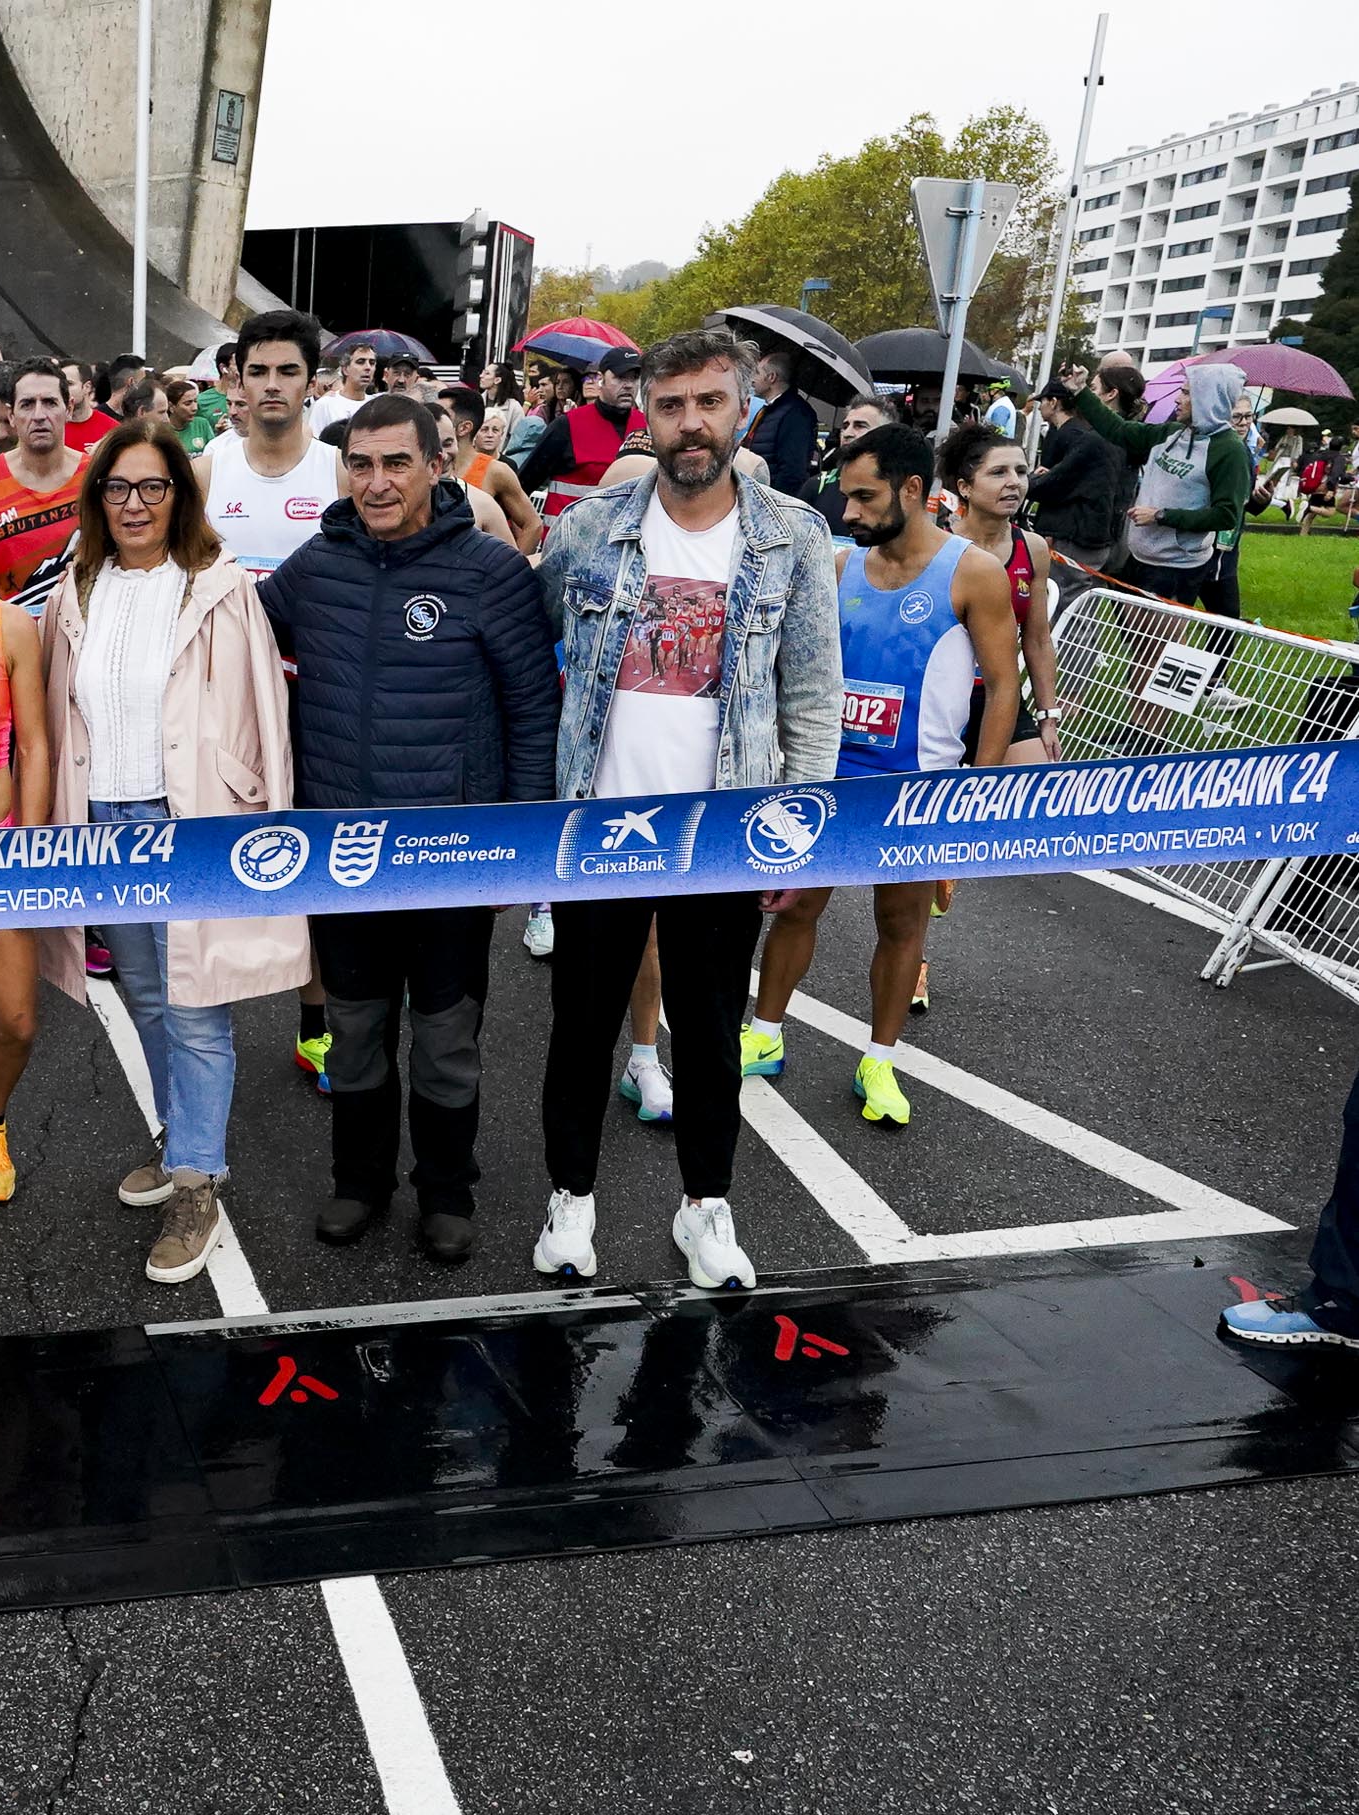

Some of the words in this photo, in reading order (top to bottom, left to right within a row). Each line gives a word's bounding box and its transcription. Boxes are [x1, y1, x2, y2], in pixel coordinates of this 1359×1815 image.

[403, 631, 435, 641] PONTEVEDRA
[883, 778, 957, 827] XLII
[946, 772, 1040, 824] GRAN
[1028, 766, 1135, 819] FONDO
[1126, 753, 1300, 814] CAIXABANK
[1289, 750, 1340, 804] 24
[739, 789, 795, 824] SOCIEDAD
[129, 823, 177, 864] 24
[246, 831, 298, 847] DEPORTE
[394, 832, 470, 848] Concello
[877, 844, 926, 867] XXIX
[927, 841, 989, 865] MEDIO
[992, 831, 1090, 861] MARATÓN
[1093, 833, 1119, 854] DE
[1121, 825, 1247, 852] PONTEVEDRA
[240, 852, 299, 882] PONTEVEDRA
[392, 852, 416, 866] de
[418, 847, 516, 865] Pontevedra
[579, 854, 667, 875] CaixaBank
[745, 852, 814, 875] PONTEVEDRA
